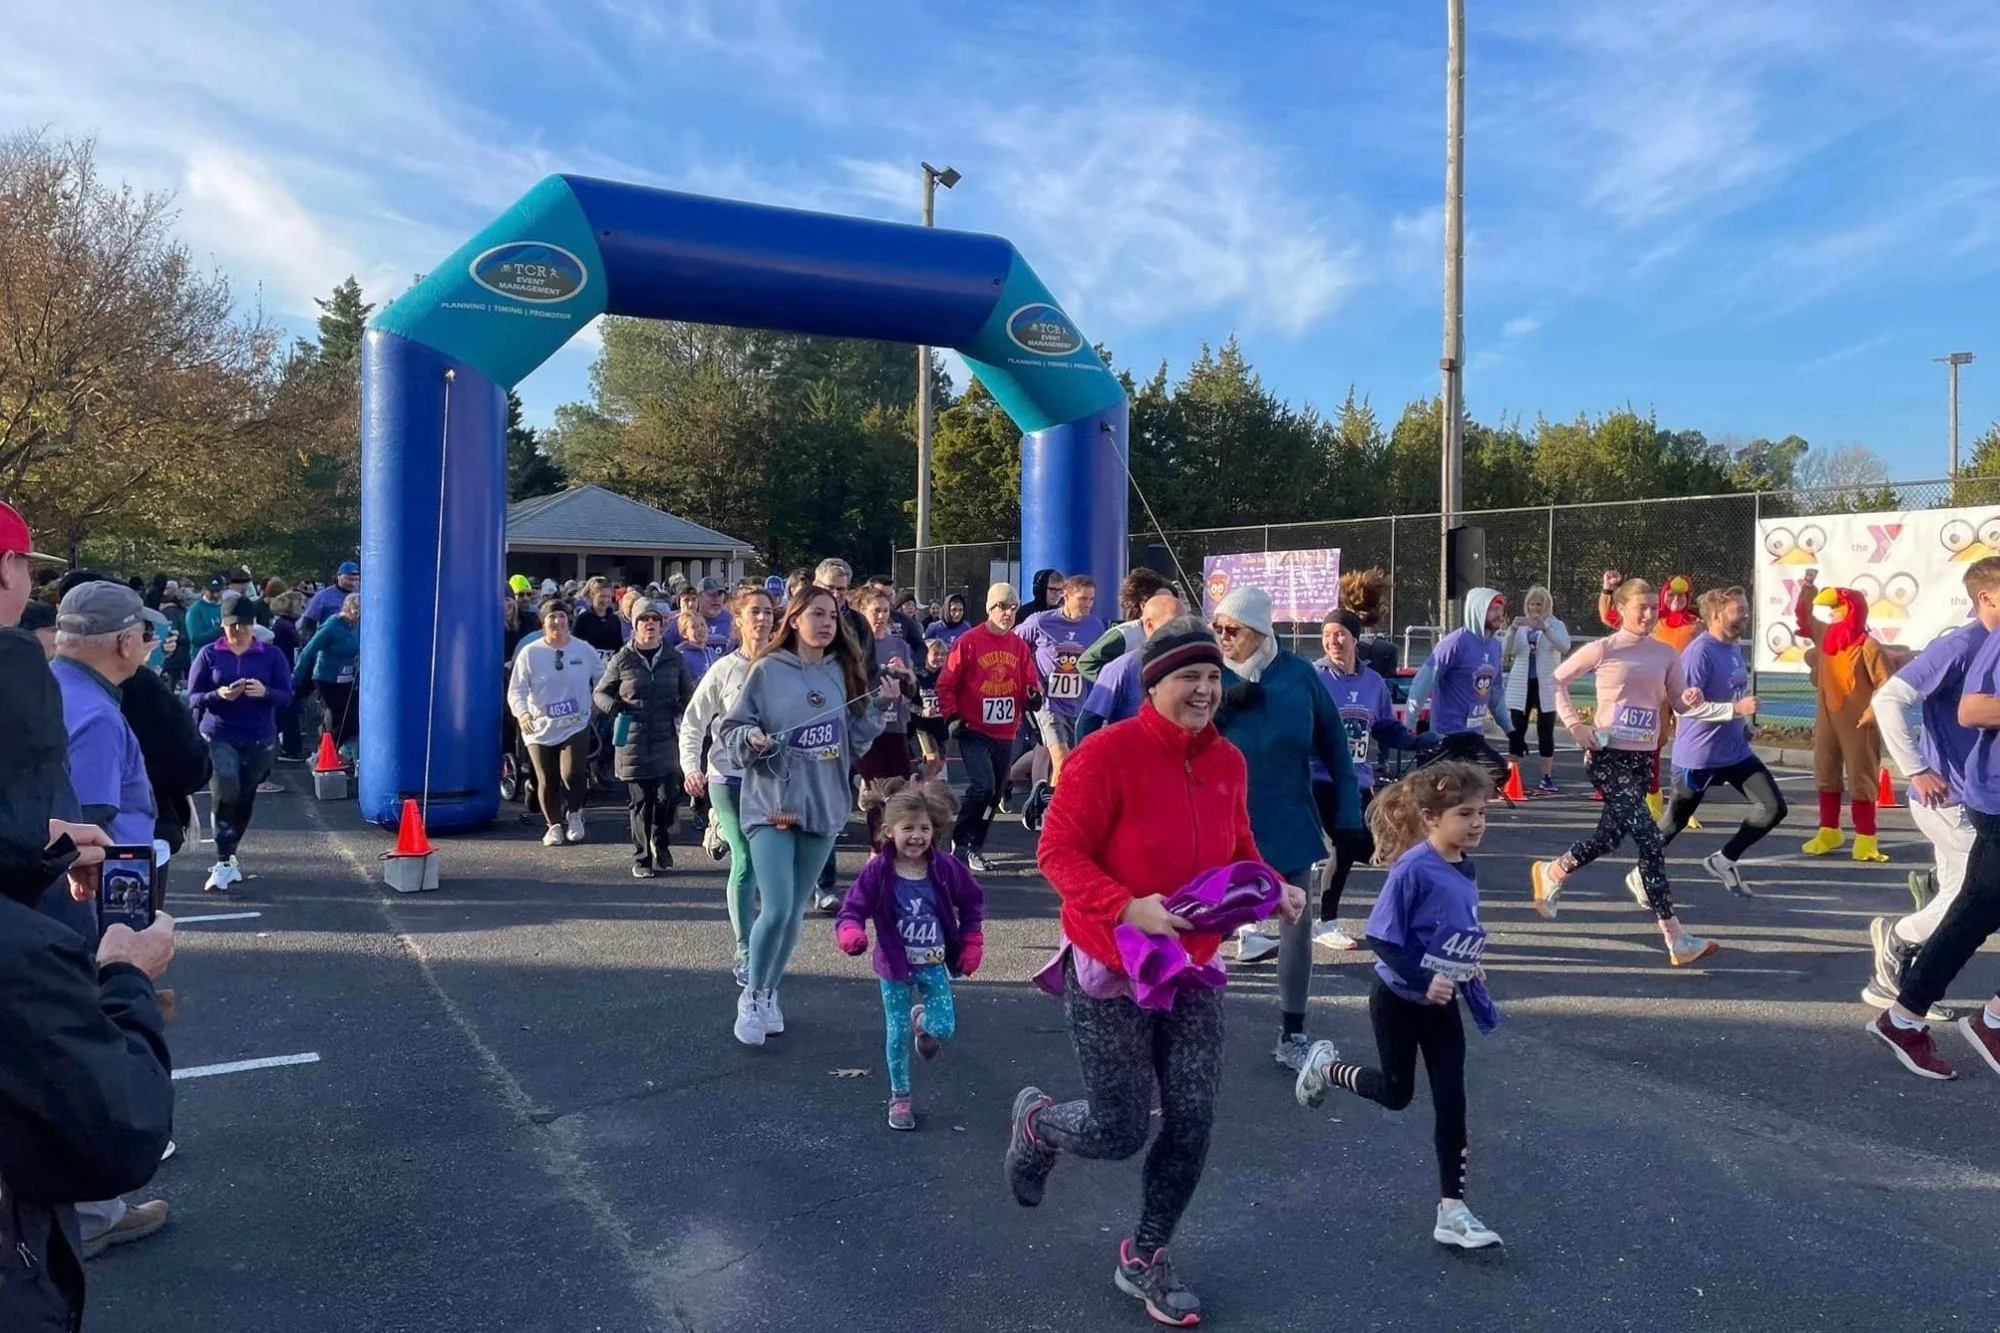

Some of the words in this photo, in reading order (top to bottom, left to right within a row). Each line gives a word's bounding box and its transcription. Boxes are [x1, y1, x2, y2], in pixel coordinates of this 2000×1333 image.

[514, 263, 547, 277] TCR
[516, 276, 545, 286] EVENT
[499, 282, 561, 295] MANAGEMENT
[441, 302, 485, 310] PLANNING
[494, 305, 523, 314] TIMING
[529, 309, 571, 319] PROMOTION
[1040, 324, 1061, 334] TCR
[1028, 340, 1072, 349] MANAGEMENT
[1008, 358, 1041, 366] PLANNING
[1851, 544, 1869, 552] the
[1951, 596, 1968, 606] the
[1052, 674, 1080, 695] 701
[549, 702, 573, 717] 4621
[985, 698, 1013, 720] 732
[1620, 708, 1653, 727] 4672
[798, 723, 833, 747] 4538
